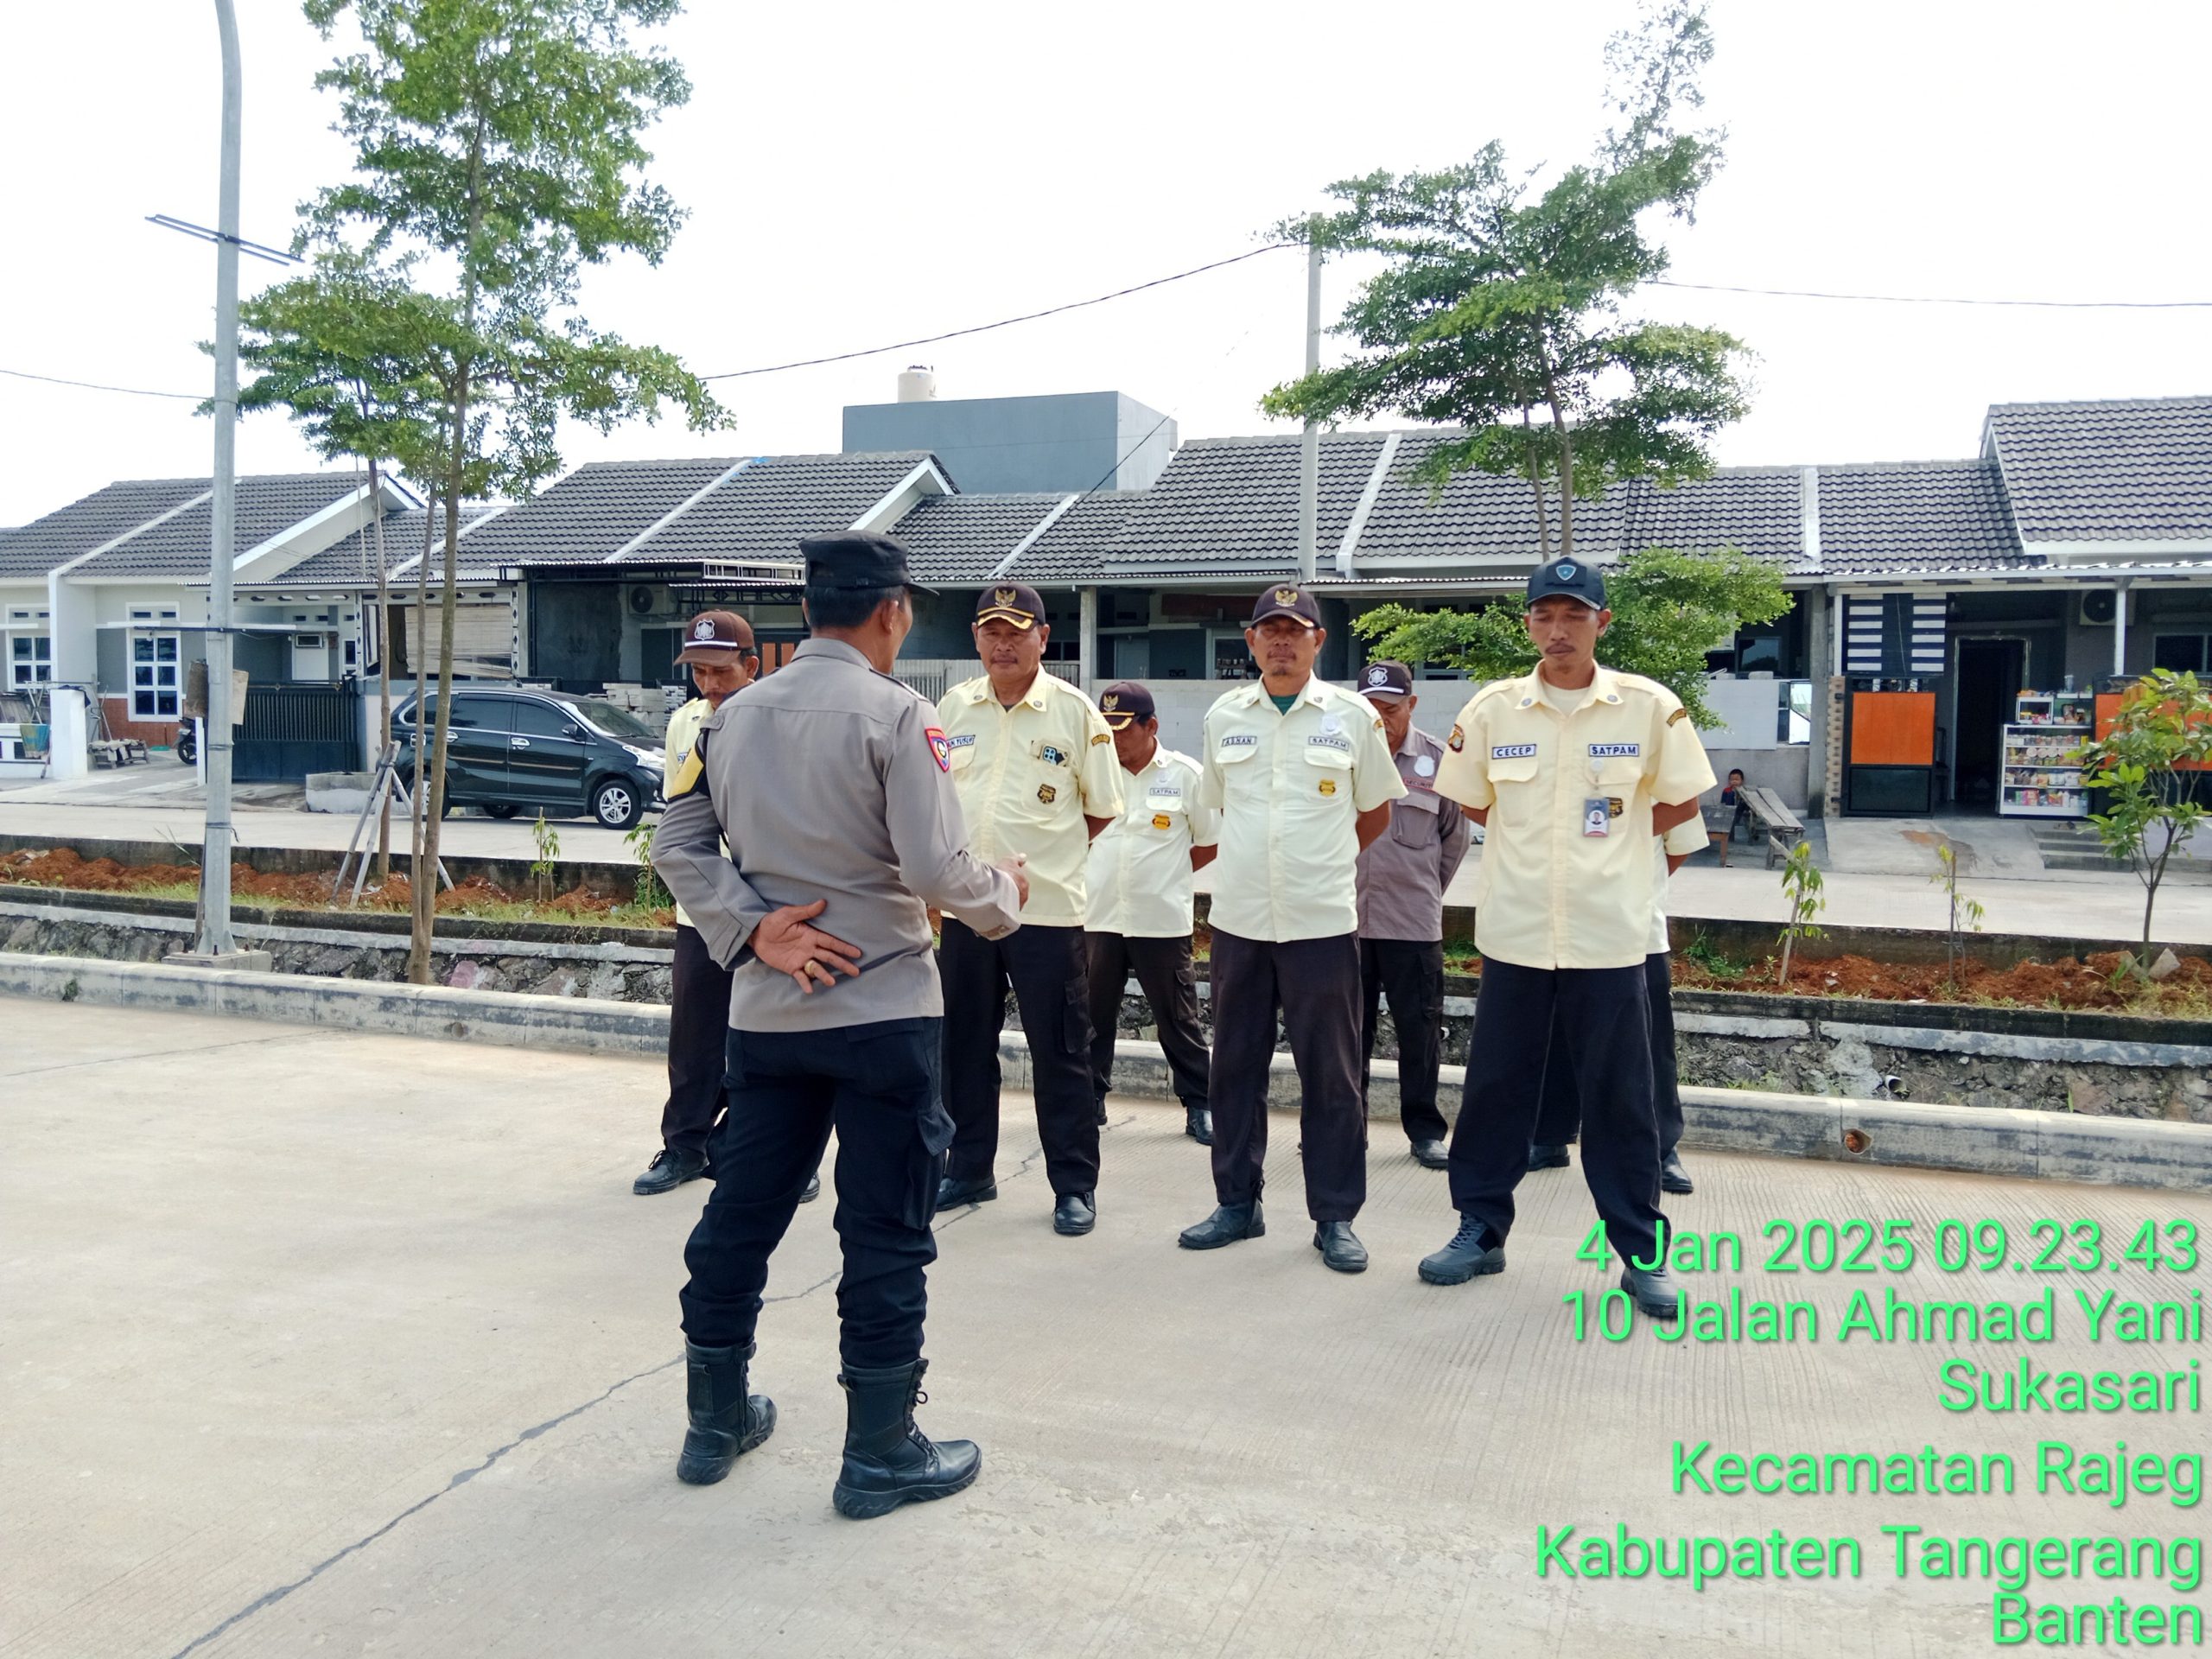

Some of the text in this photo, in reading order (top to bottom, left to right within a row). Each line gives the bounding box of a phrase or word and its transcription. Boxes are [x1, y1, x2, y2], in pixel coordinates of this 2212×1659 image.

[1313, 738, 1346, 747] SATPAM
[1496, 747, 1531, 757] CECEP
[1592, 746, 1637, 755] SATPAM
